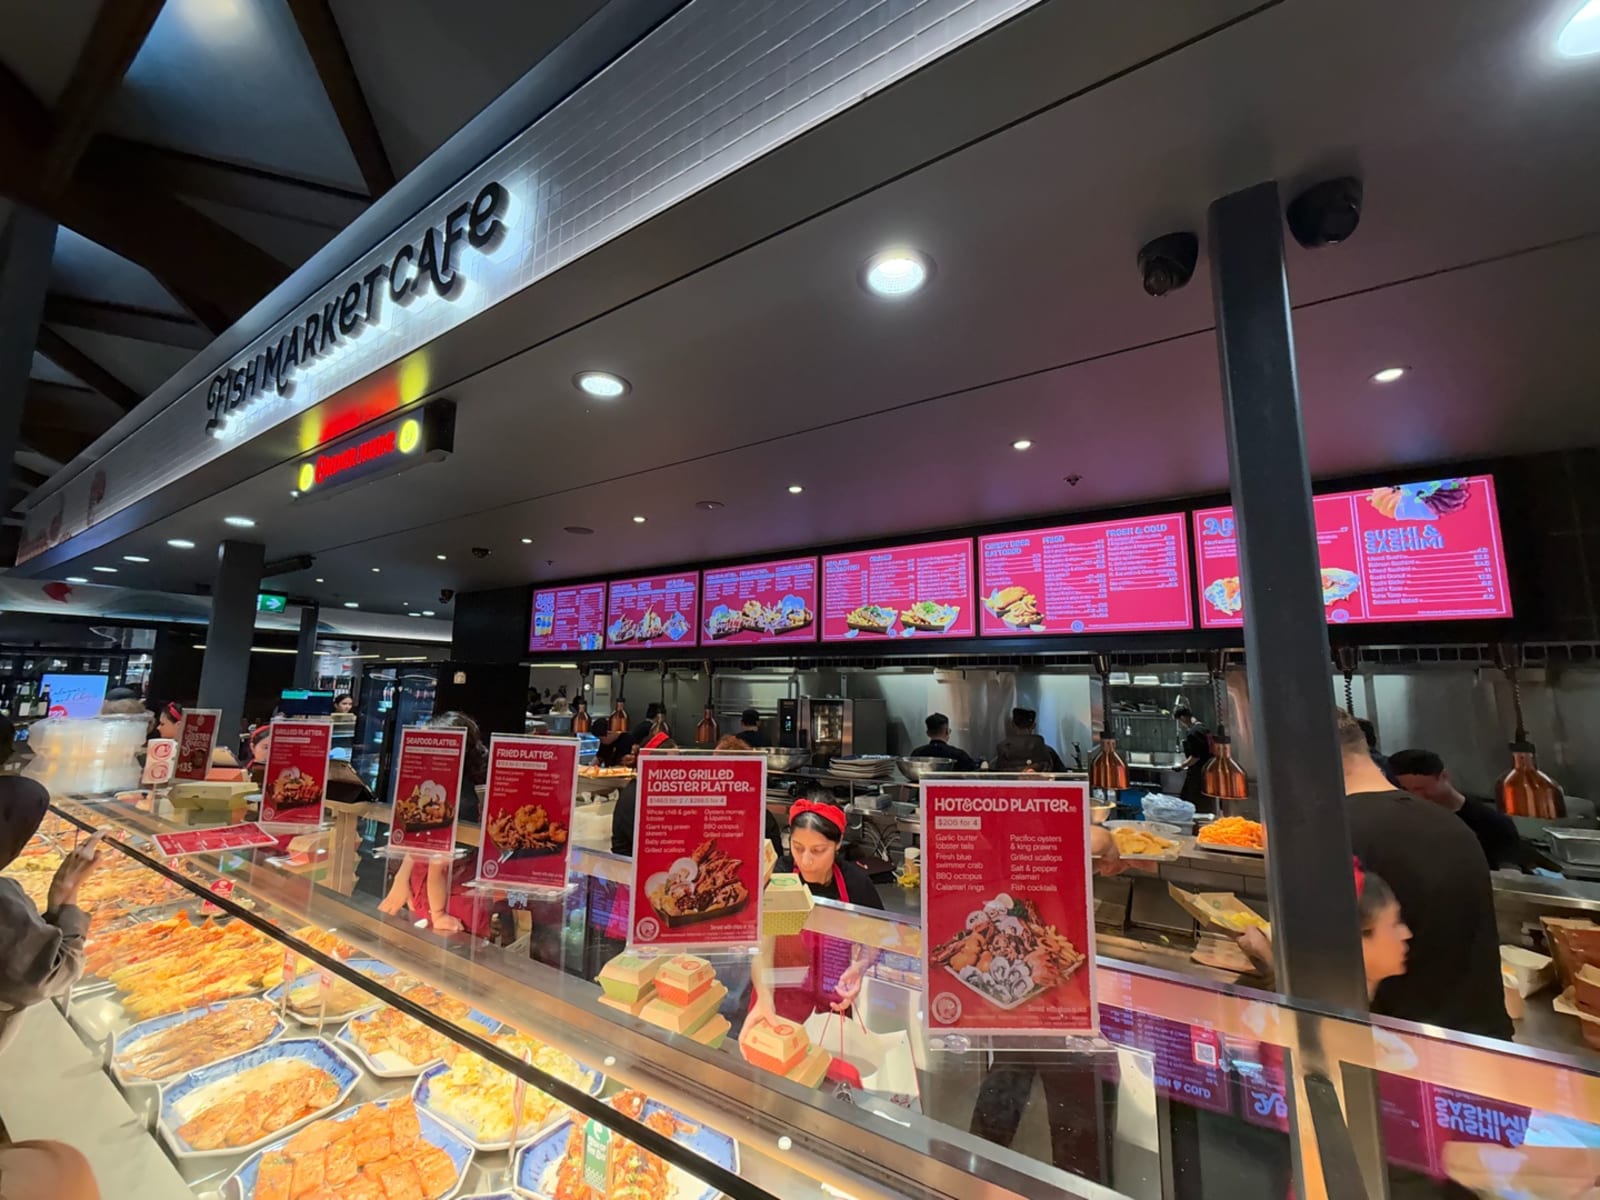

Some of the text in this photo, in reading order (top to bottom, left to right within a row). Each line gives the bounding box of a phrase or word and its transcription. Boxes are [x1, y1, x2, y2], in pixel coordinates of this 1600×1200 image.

[205, 181, 510, 434] FISH MARKET CAFE
[1106, 524, 1168, 537] FRESH & COLD
[1364, 524, 1439, 541] SUSHI &
[1365, 535, 1445, 554] SASHIMI
[275, 728, 322, 737] GRILLED PLATTER
[406, 737, 458, 747] SEAFOOD PLATTER
[496, 748, 554, 760] FRIED PLATTER
[648, 769, 734, 780] MIXED GRILLED
[647, 781, 750, 792] LOBSTER PLATTER
[1010, 798, 1069, 812] PLATTER
[960, 818, 971, 826] for
[1037, 835, 1062, 843] oysters
[1016, 842, 1032, 851] king
[1010, 853, 1063, 862] Grilled scallops
[1010, 864, 1024, 872] Salt
[1032, 865, 1058, 873] pepper
[935, 872, 952, 880] BBQ
[935, 883, 985, 893] Calamari rings
[1010, 883, 1026, 891] Fish
